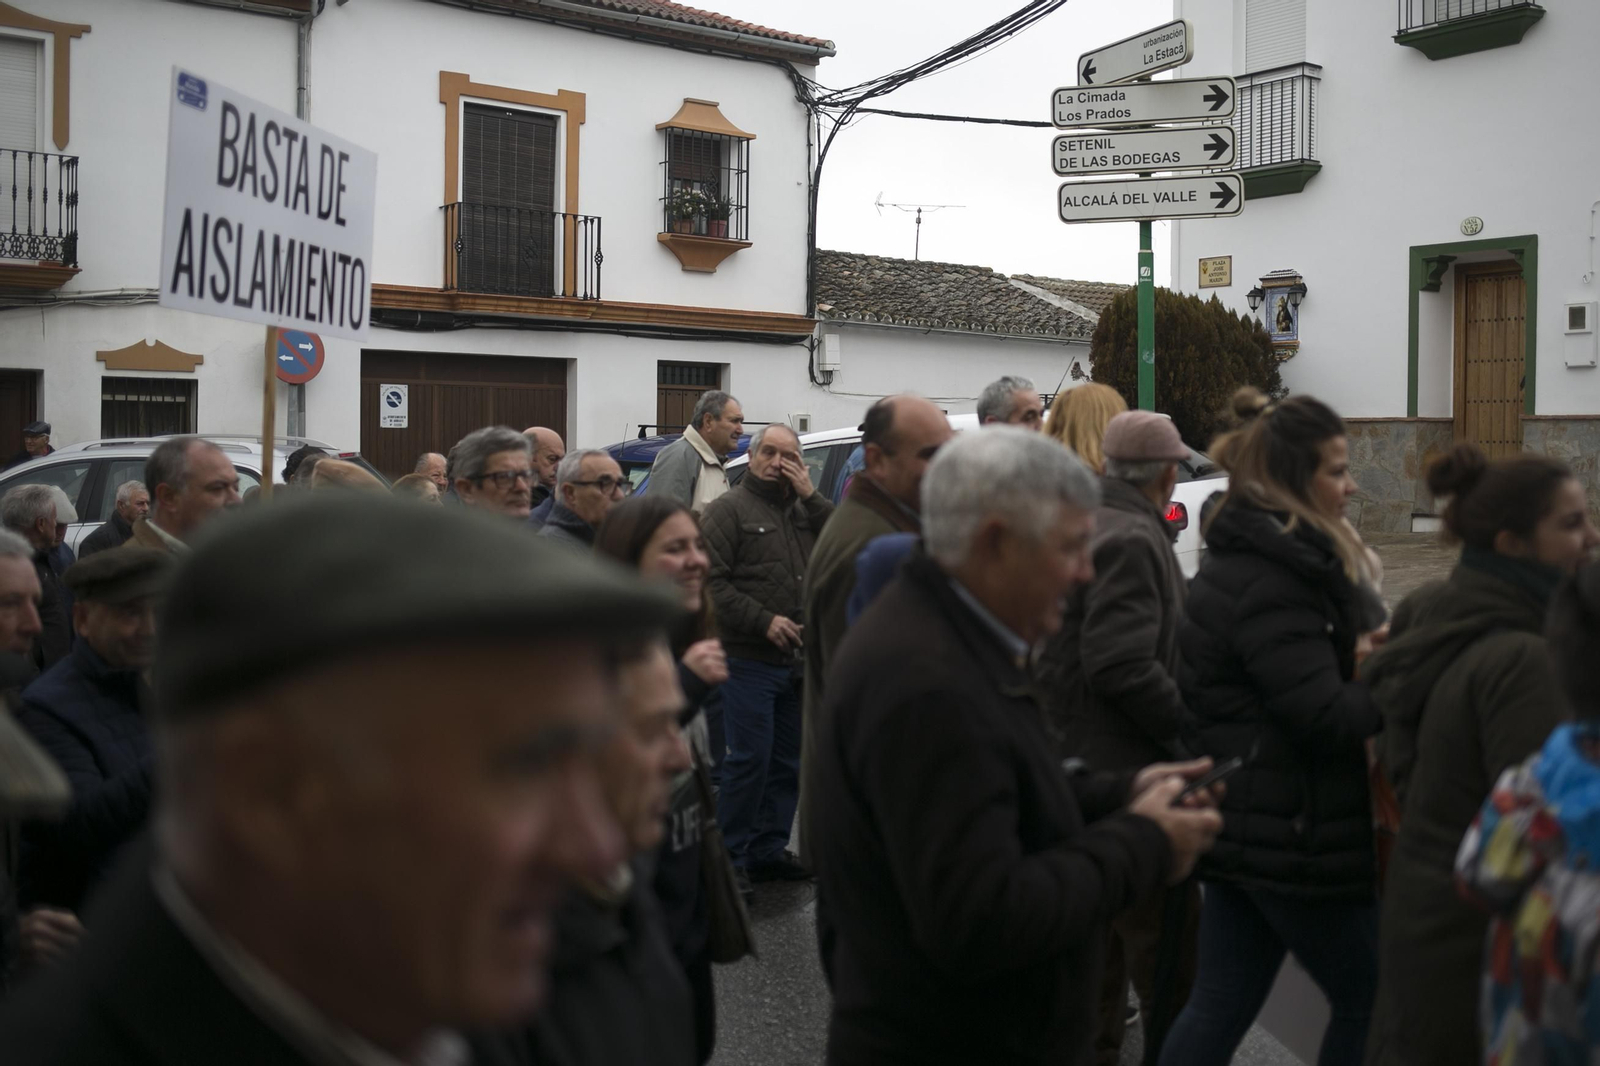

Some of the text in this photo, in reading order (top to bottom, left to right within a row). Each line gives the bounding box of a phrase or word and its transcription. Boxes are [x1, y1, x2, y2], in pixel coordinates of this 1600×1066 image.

[1143, 28, 1183, 48] urbanización
[1144, 42, 1184, 65] La Estacá
[1058, 90, 1126, 104] La Cimada
[1058, 107, 1131, 121] Los Prados
[1059, 138, 1115, 152] SETENIL
[217, 100, 350, 228] BASTA DE
[1060, 151, 1181, 169] DE LAS BODEGAS
[1063, 190, 1197, 207] ALCALÁ DEL VALLE
[170, 207, 365, 331] AISLAMIENTO
